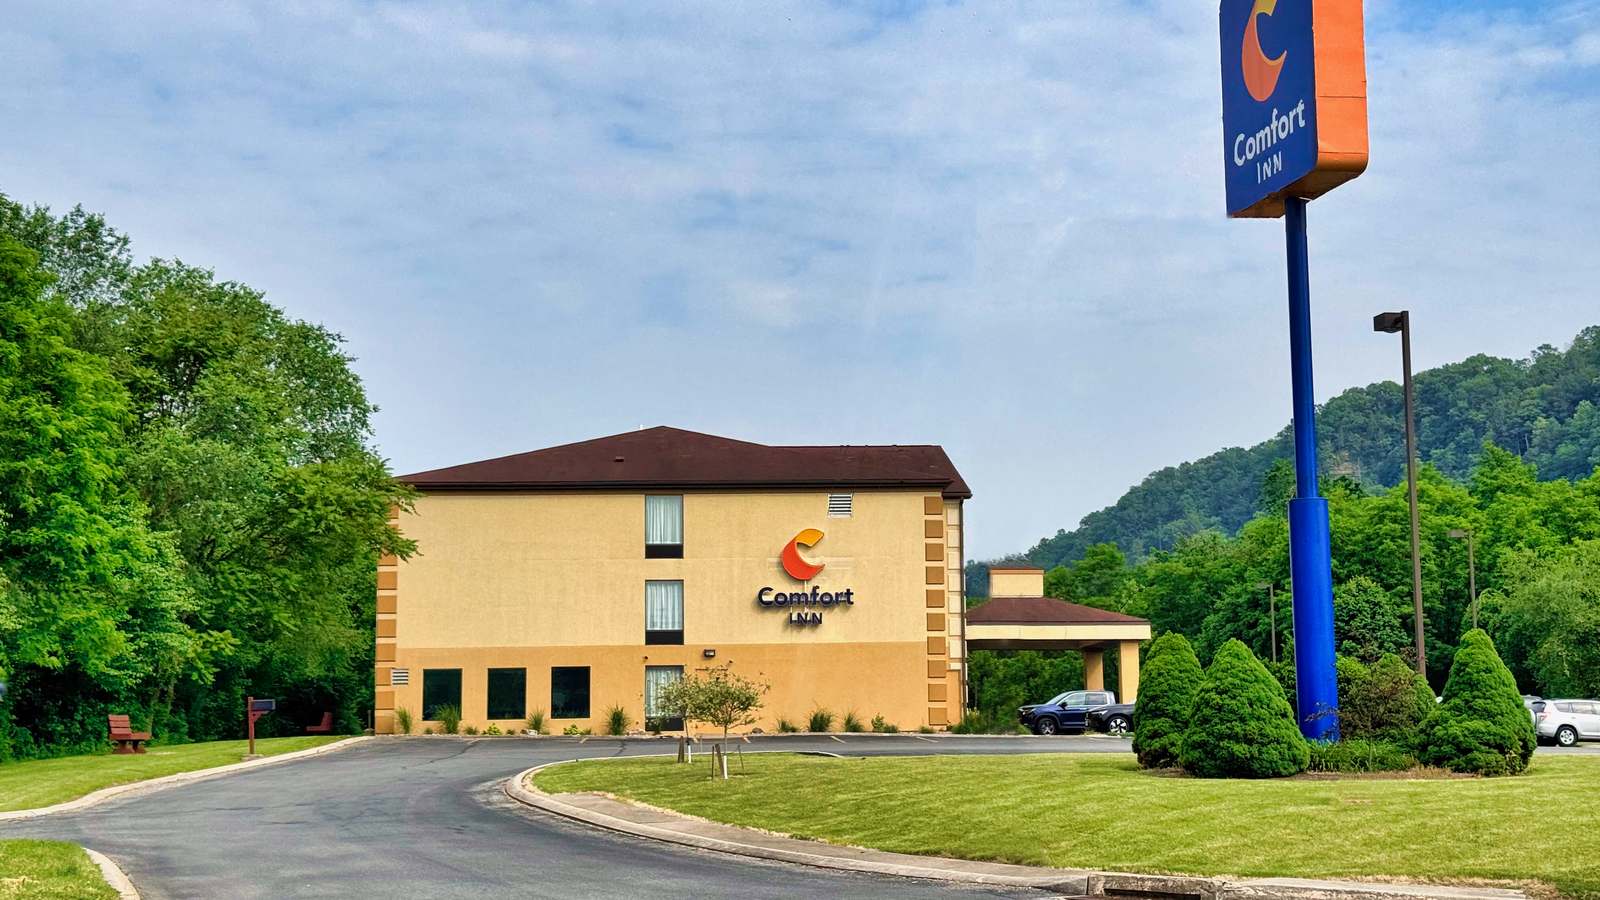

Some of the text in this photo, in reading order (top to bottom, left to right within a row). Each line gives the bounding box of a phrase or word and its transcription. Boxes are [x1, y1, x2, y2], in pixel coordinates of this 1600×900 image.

[1234, 99, 1305, 166] Comfort
[1256, 151, 1282, 184] INN
[758, 585, 854, 606] Comfort
[789, 612, 823, 625] INN
